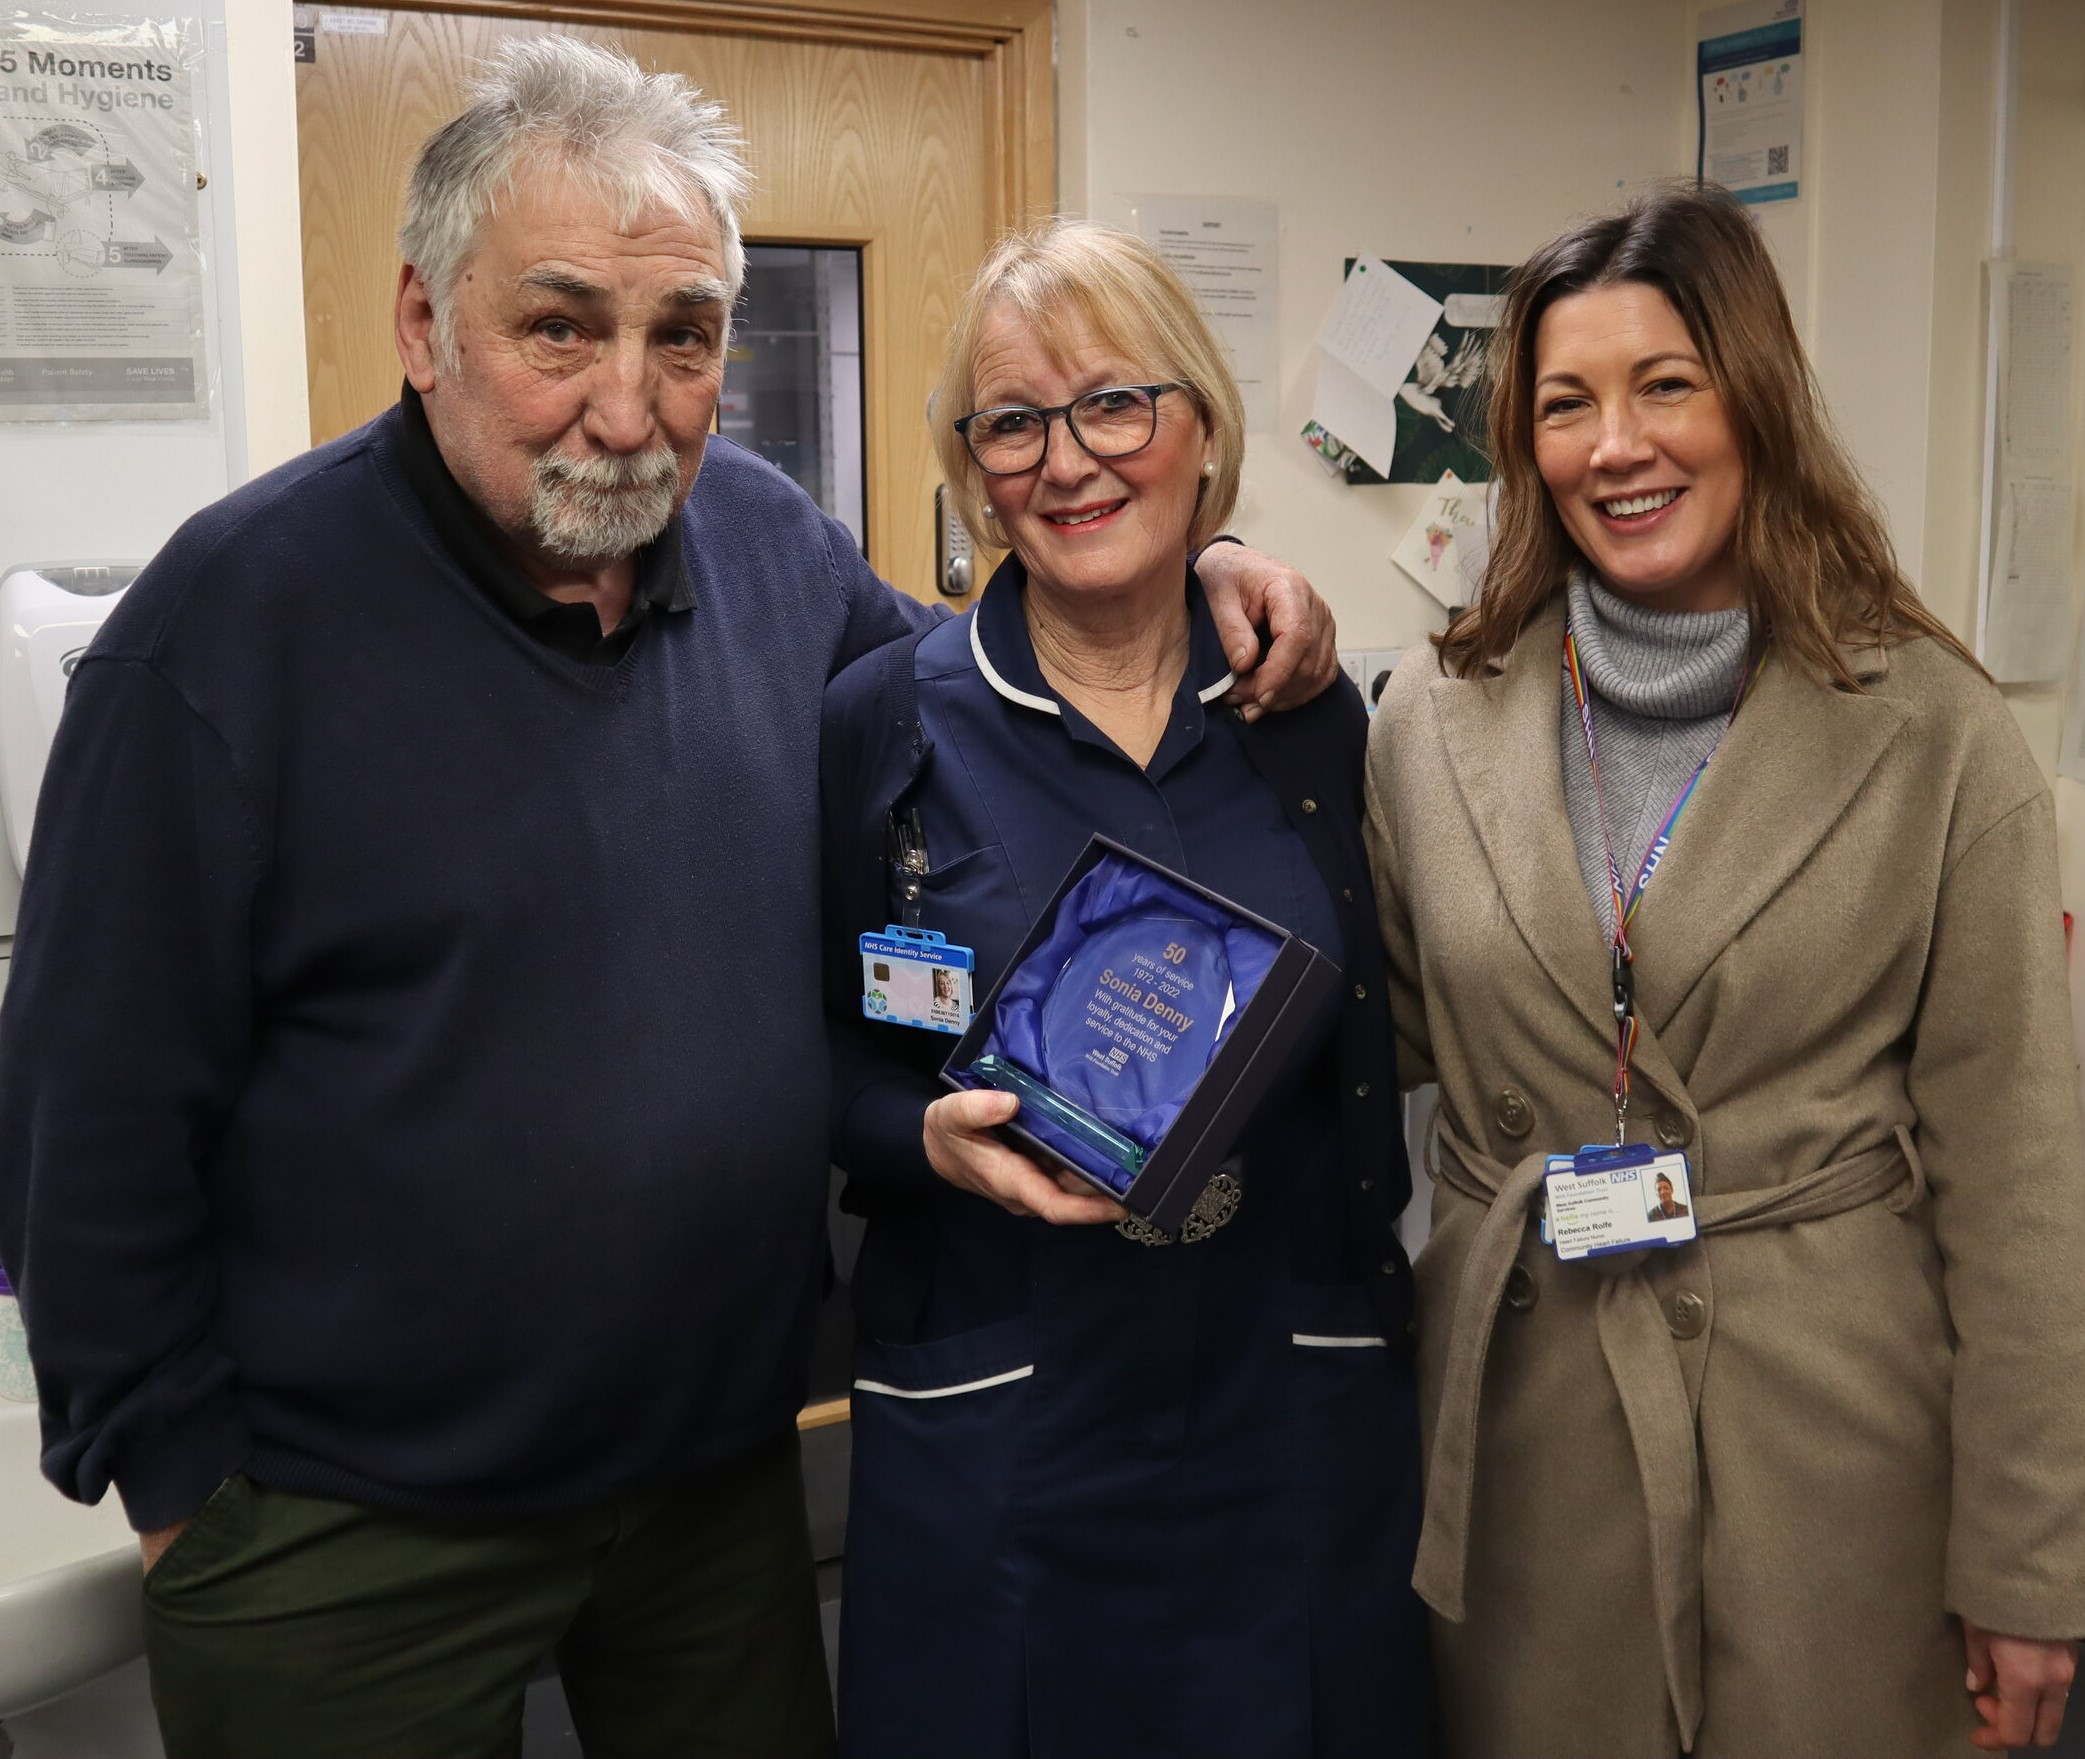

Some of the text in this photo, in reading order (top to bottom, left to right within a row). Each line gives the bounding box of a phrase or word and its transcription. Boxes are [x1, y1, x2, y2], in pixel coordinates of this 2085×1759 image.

[0, 50, 173, 82] 5 Moments
[58, 82, 174, 112] Hygiene
[95, 168, 108, 186] 4
[108, 246, 122, 263] 5
[126, 368, 148, 376] SAVE
[150, 368, 175, 376] LIVES
[1638, 835, 1670, 890] NHS
[865, 942, 942, 961] NHS Care Identity Service
[1162, 942, 1186, 965] 50
[1132, 952, 1194, 991] years of service
[1133, 968, 1154, 984] 1972
[1158, 981, 1181, 998] 2022
[1099, 968, 1194, 1033] Sonia Denny
[1094, 988, 1179, 1043] With gratitude for your
[1086, 1001, 1172, 1055] loyalty, dedication and
[1085, 1018, 1159, 1063] service to the NHS
[1092, 1049, 1105, 1060] West
[1110, 1048, 1128, 1064] NHS
[1554, 1170, 1636, 1192] West Suffolk NHS
[1558, 1222, 1613, 1236] Rebecca Rolfe
[1561, 1243, 1592, 1253] Community
